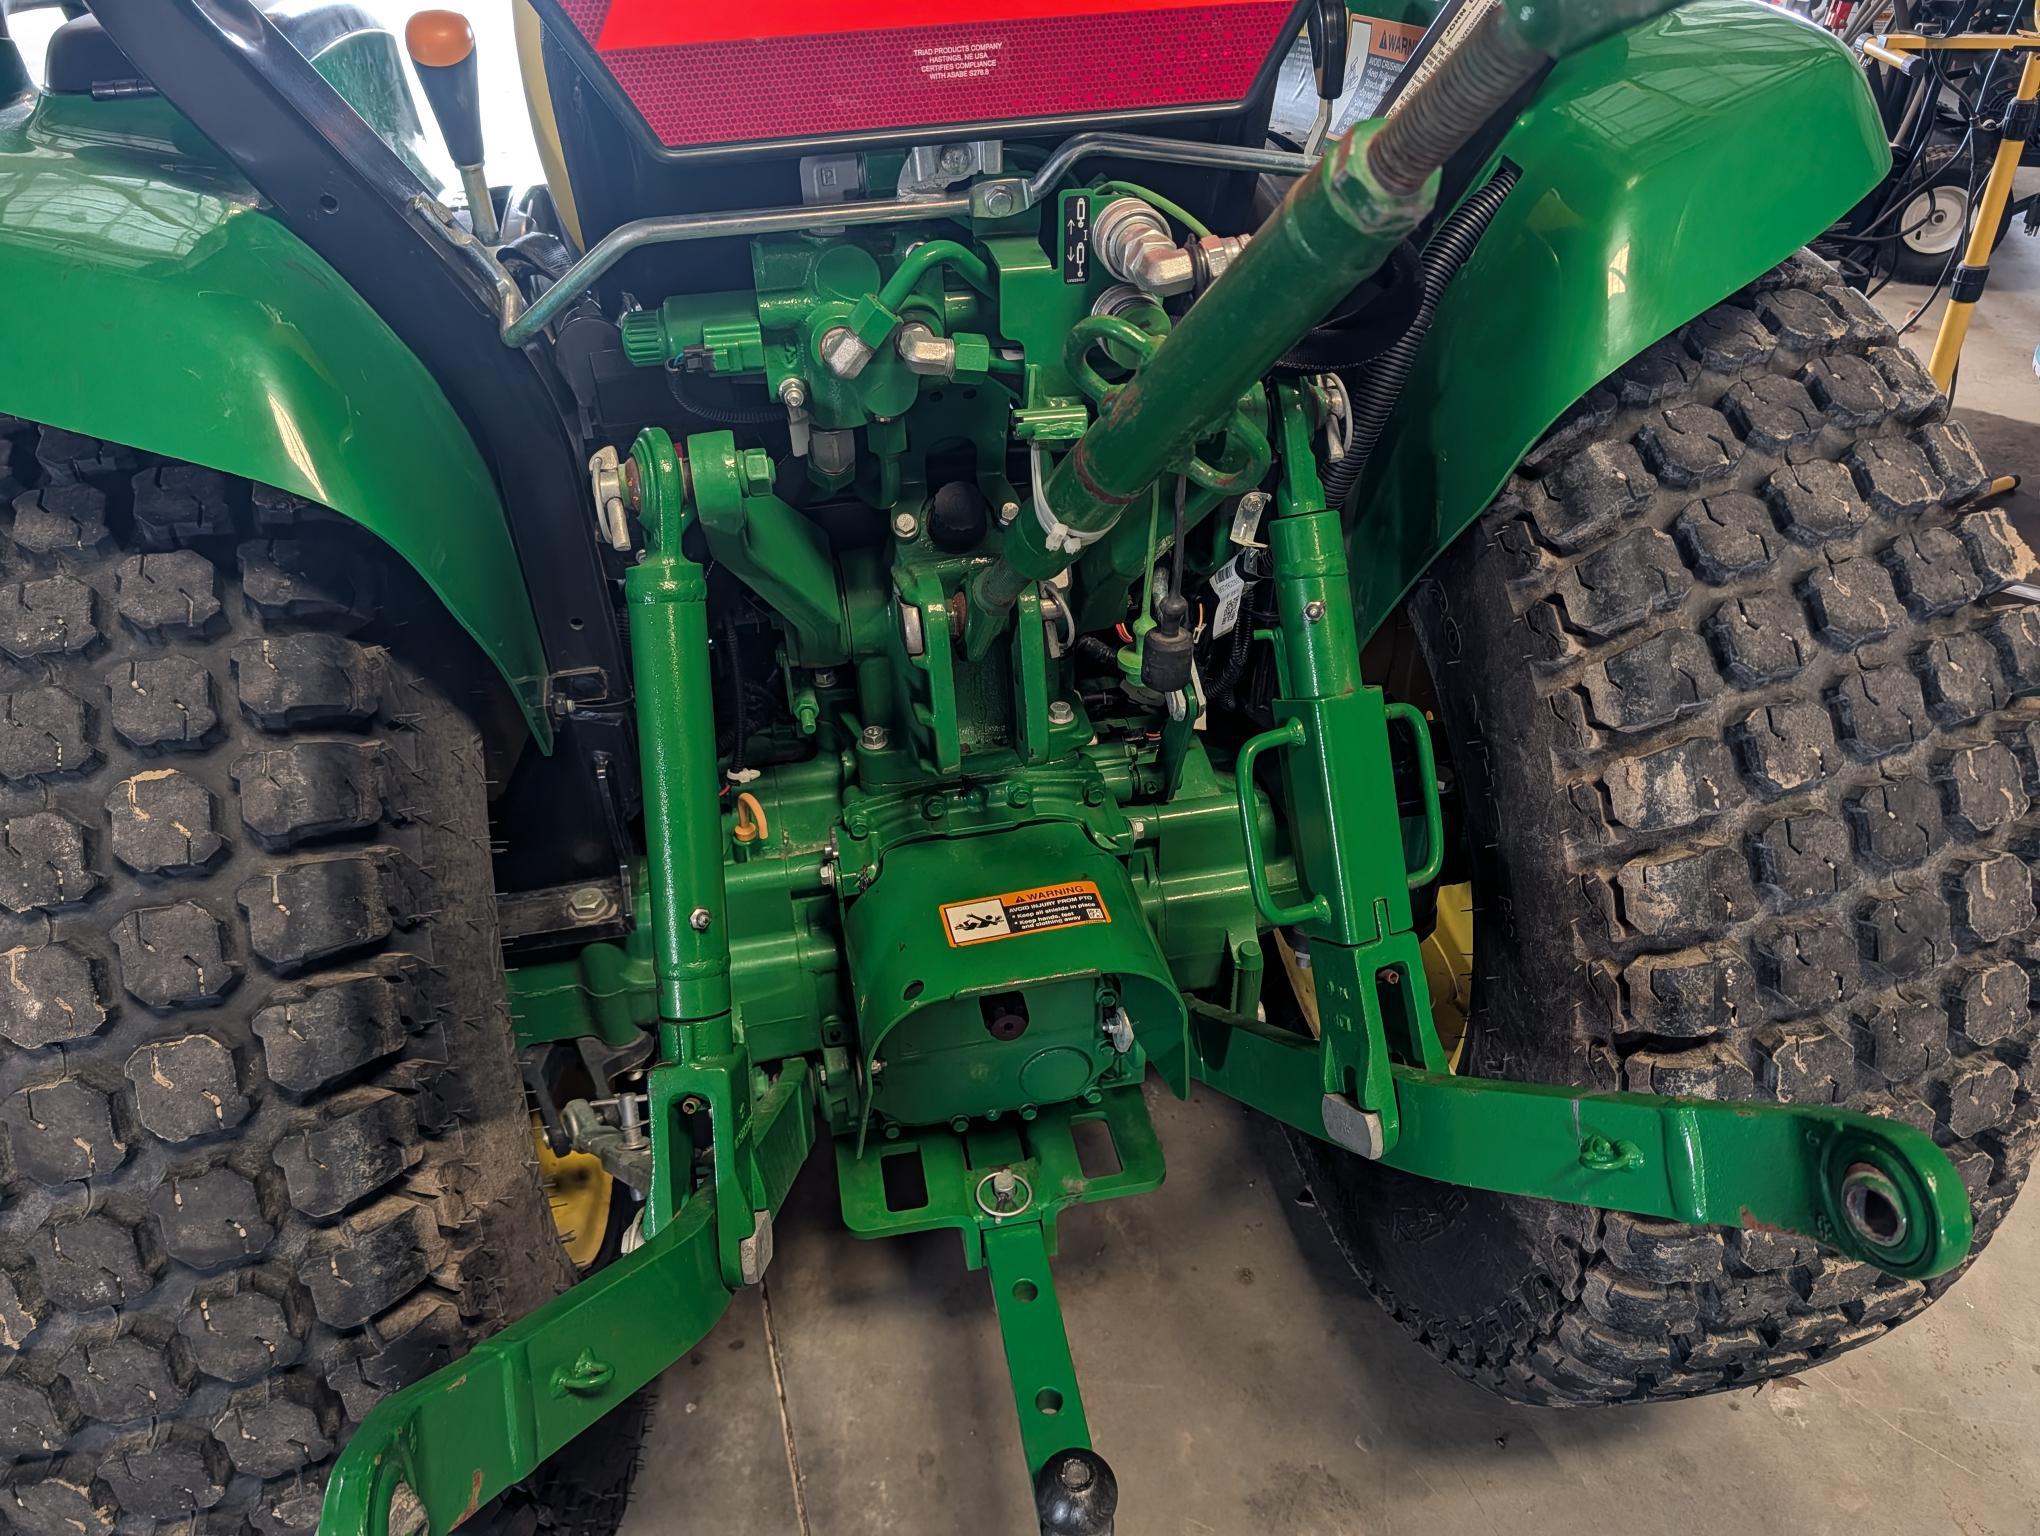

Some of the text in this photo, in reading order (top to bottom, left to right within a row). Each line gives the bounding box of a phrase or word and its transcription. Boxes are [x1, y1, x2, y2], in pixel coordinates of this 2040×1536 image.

[1446, 8, 1467, 37] JOHN
[913, 42, 1003, 57] TRIAD PRODUCTS COMPANY
[1389, 33, 1416, 56] WARN
[921, 59, 997, 73] CERTIFIES COMPLIANCE
[929, 72, 946, 80] WITH
[947, 70, 968, 79] ASABE
[1026, 885, 1084, 901] WARNING
[1009, 904, 1030, 913] AVOID
[1030, 901, 1056, 909] INJURY
[1057, 896, 1078, 905] FROM
[1017, 911, 1034, 919] Keep
[1045, 905, 1069, 914] shields
[1035, 918, 1063, 927] clothing
